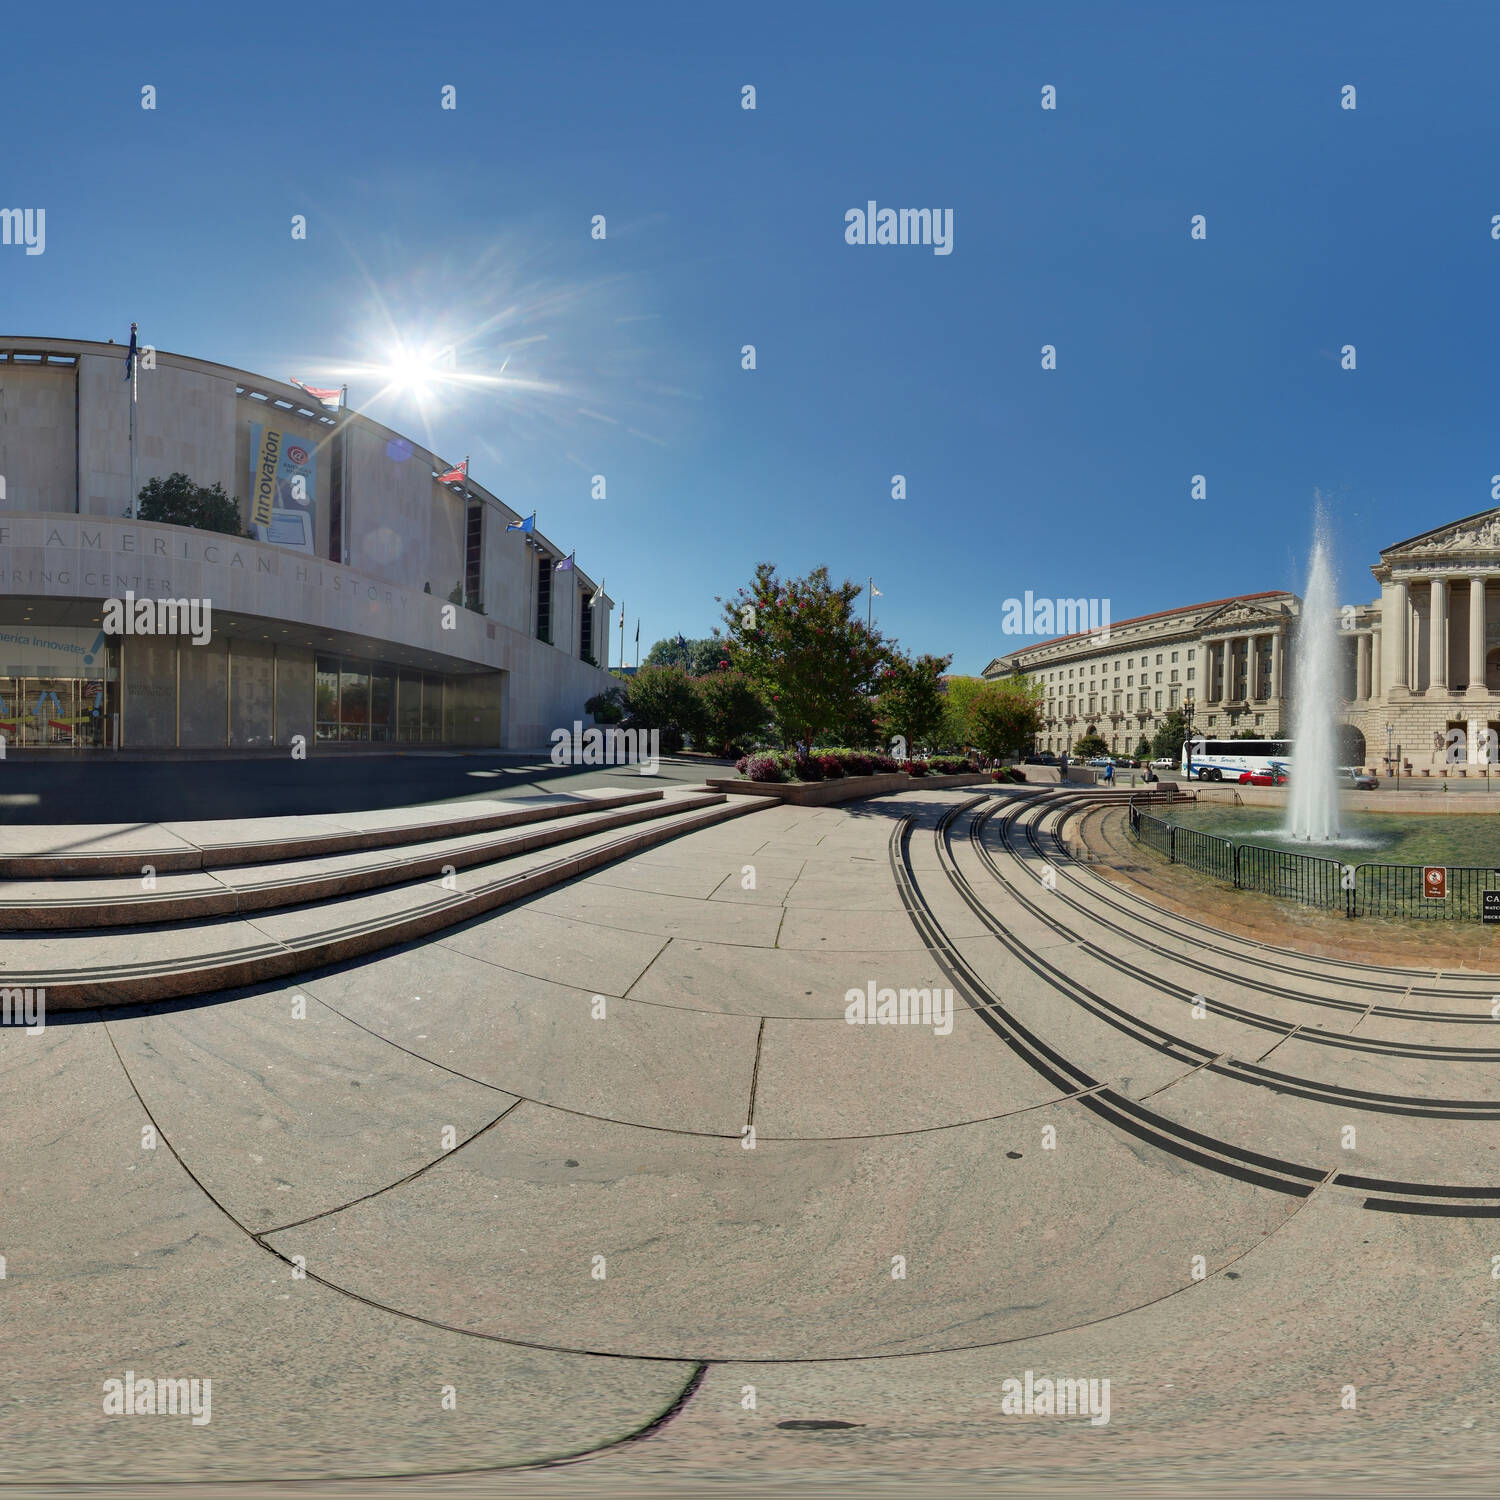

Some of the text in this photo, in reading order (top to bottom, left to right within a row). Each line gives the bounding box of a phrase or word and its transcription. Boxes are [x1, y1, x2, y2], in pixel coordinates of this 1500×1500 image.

[255, 431, 281, 525] Innovation
[46, 529, 271, 574] AMERICAN
[296, 565, 408, 608] HISTORY
[85, 573, 171, 591] CENTER
